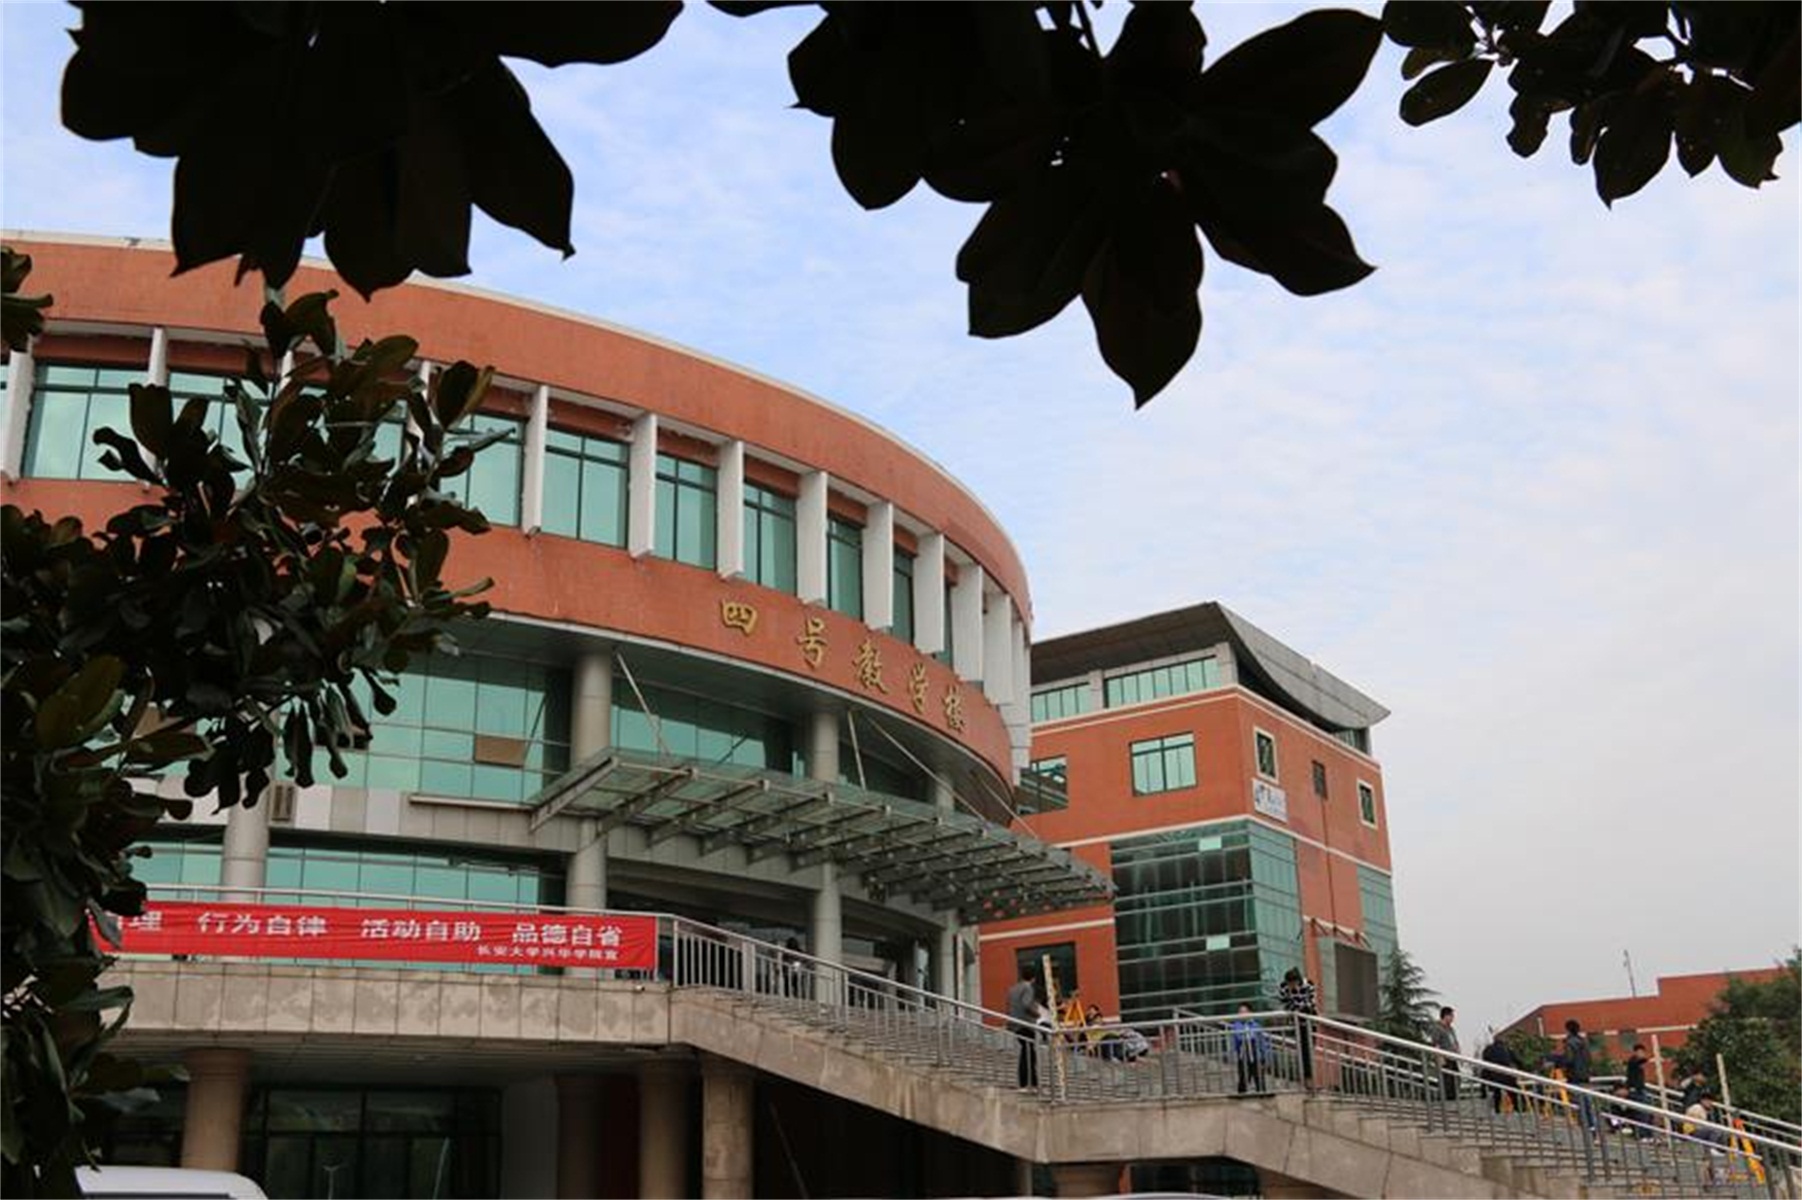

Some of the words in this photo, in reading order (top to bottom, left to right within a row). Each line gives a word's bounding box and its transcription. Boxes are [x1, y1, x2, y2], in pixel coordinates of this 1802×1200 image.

[198, 912, 328, 936] 行为自律
[361, 918, 480, 941] 活动自助
[512, 923, 622, 946] 品德自省
